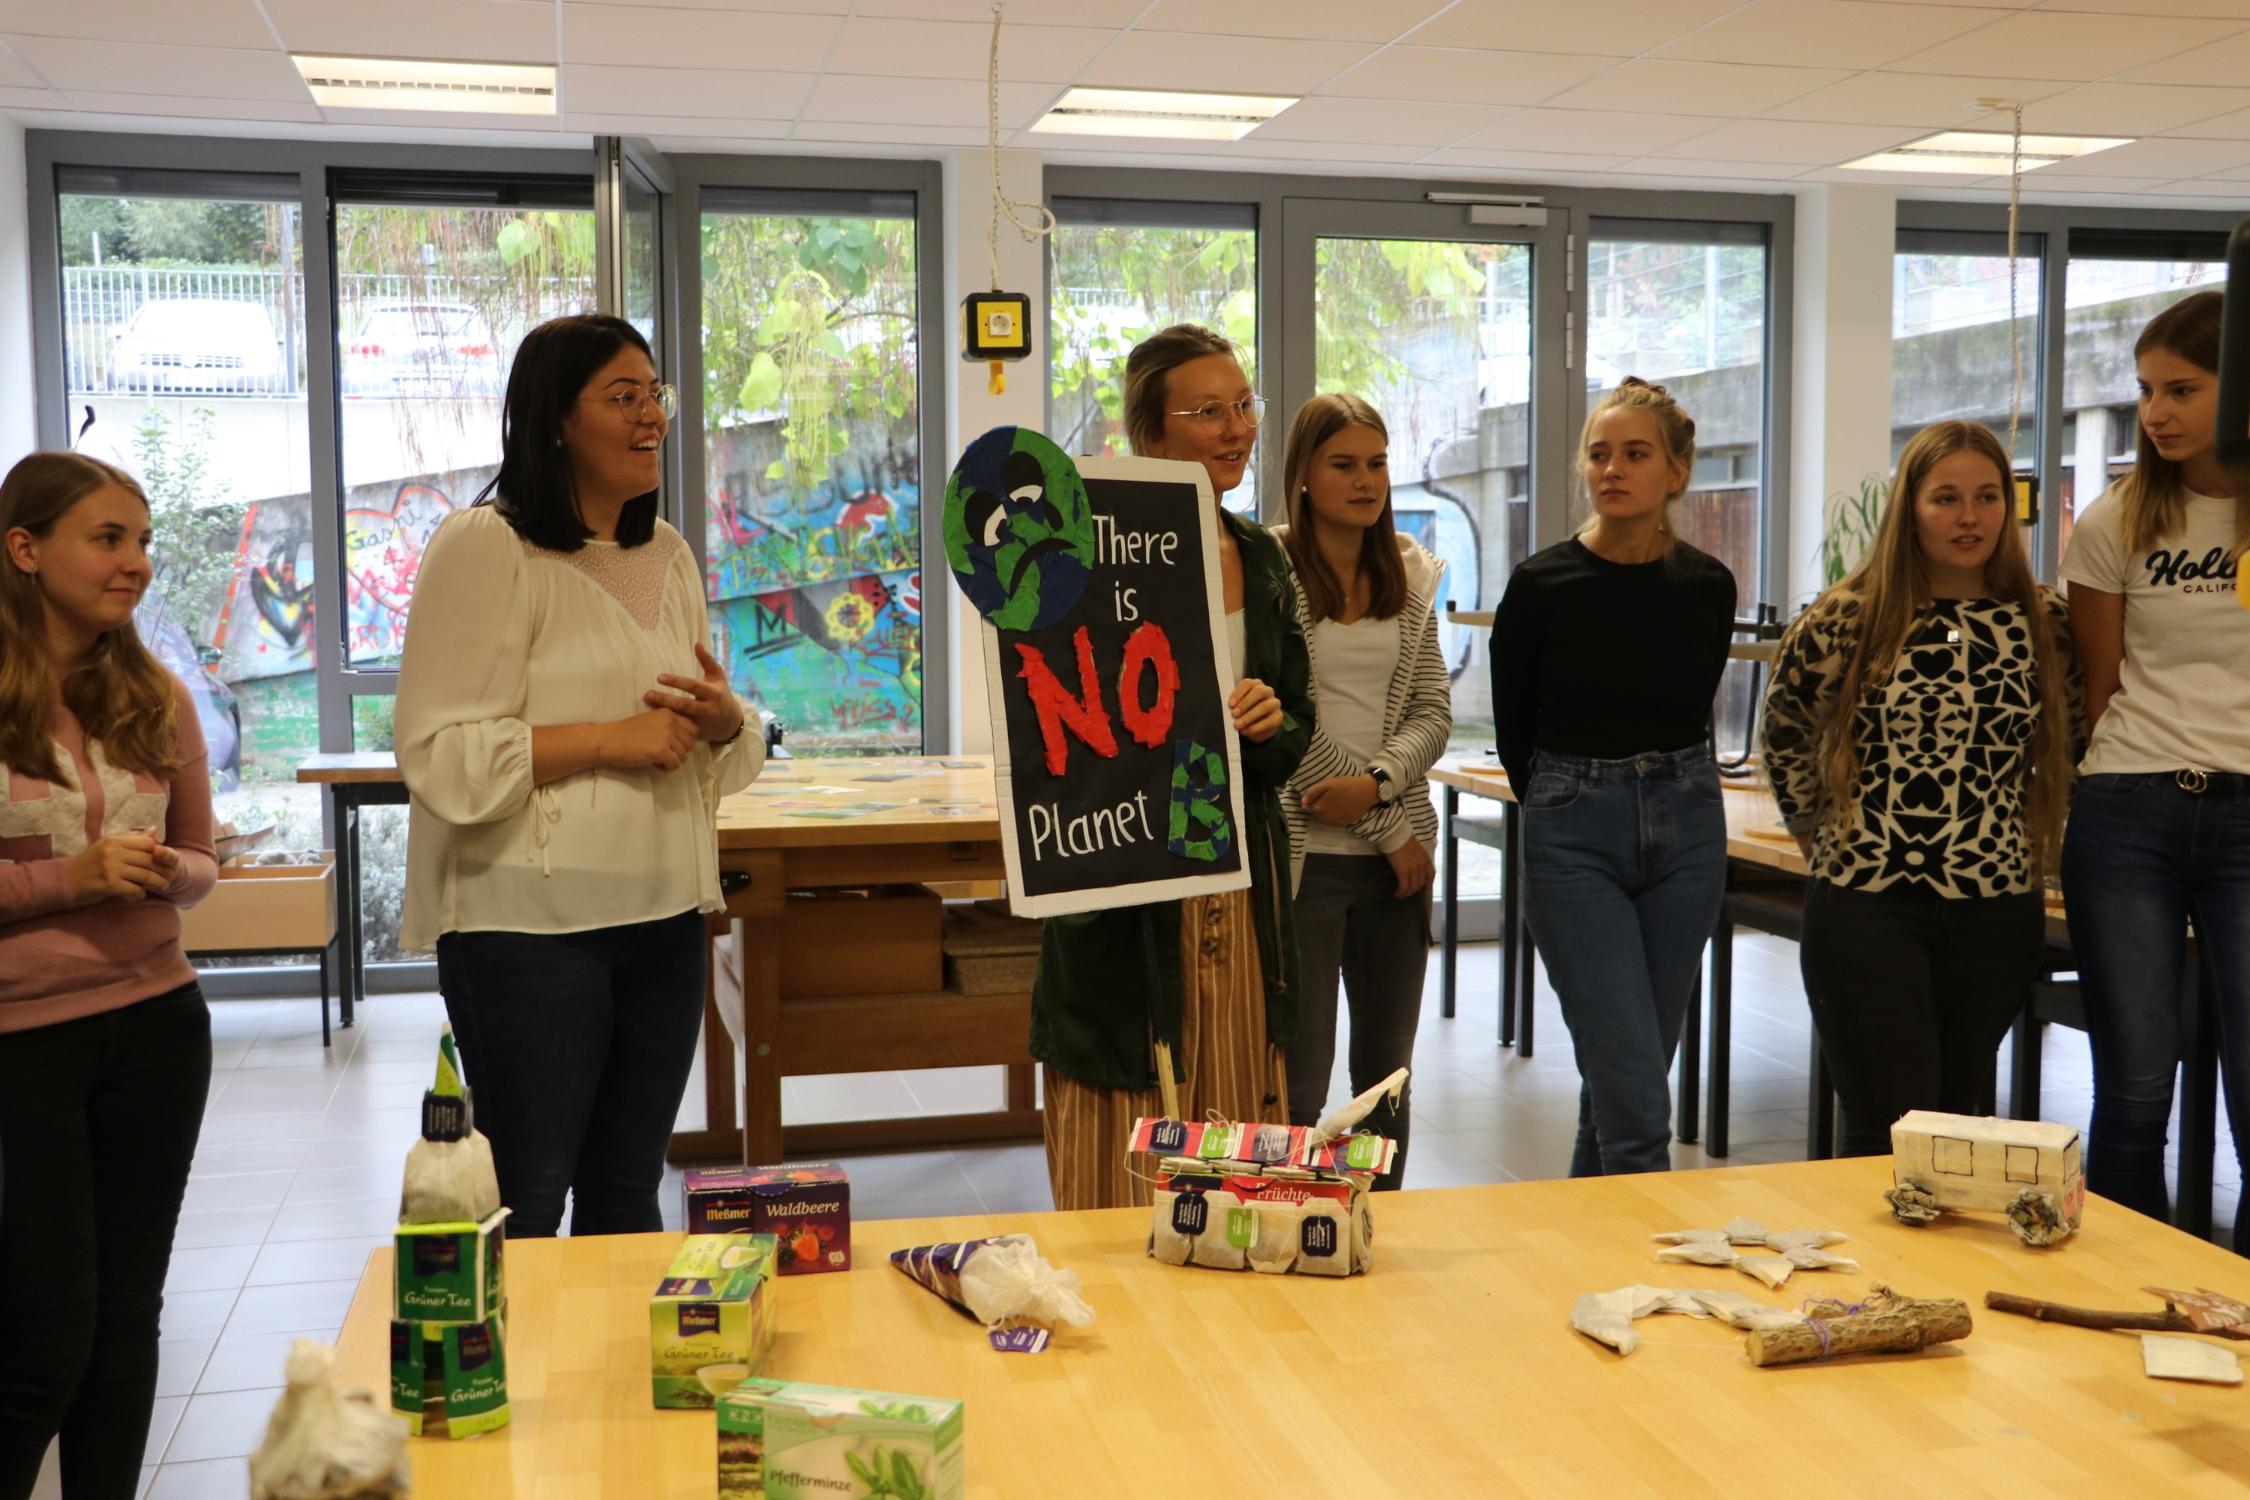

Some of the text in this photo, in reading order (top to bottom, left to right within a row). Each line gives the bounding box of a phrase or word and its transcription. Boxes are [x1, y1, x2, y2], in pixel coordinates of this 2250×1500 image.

[1091, 514, 1179, 567] There
[2145, 547, 2237, 586] Holl
[1114, 580, 1139, 622] is
[1014, 620, 1181, 778] NO
[1029, 740, 1231, 862] Planet B
[1256, 1182, 1311, 1201] Früchte
[706, 1208, 751, 1221] Meßmer
[766, 1202, 840, 1217] Waldbeere
[404, 1291, 471, 1306] Grüner Tee
[664, 1346, 734, 1359] Grüner Tee
[399, 1383, 420, 1398] Tee
[451, 1386, 493, 1402] Grüner
[769, 1469, 852, 1492] Pfefferminze
